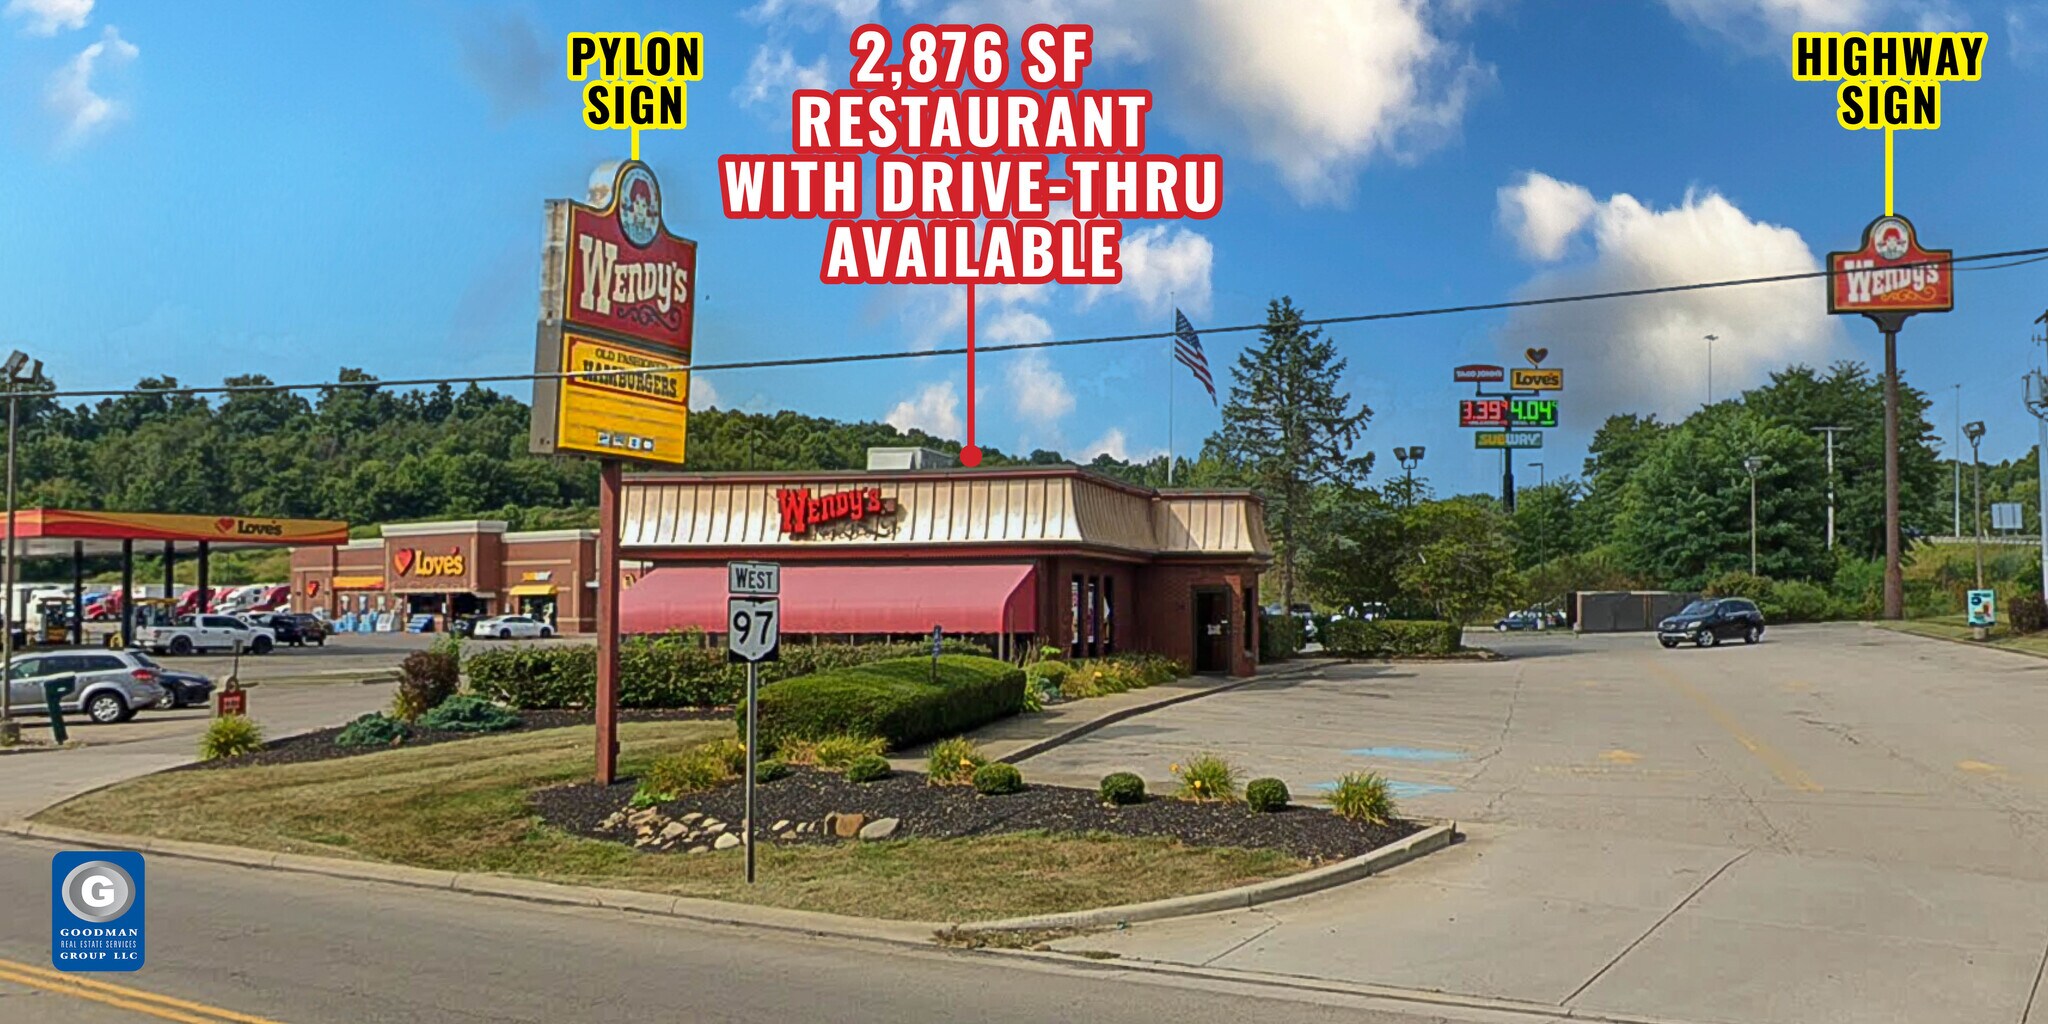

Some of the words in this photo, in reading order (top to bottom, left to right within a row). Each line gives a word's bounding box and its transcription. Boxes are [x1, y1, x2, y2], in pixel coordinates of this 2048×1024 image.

[580, 234, 687, 315] Wendy's
[1844, 260, 1939, 303] Wendys
[595, 348, 615, 361] OLD
[583, 360, 677, 397] HAMBURGERS
[1515, 372, 1559, 386] Love's
[1478, 433, 1540, 446] SUBWAY
[777, 487, 881, 533] Wendy's
[237, 520, 283, 536] Love's
[415, 547, 465, 576] Love's
[735, 567, 773, 590] WEST
[733, 610, 773, 645] 97
